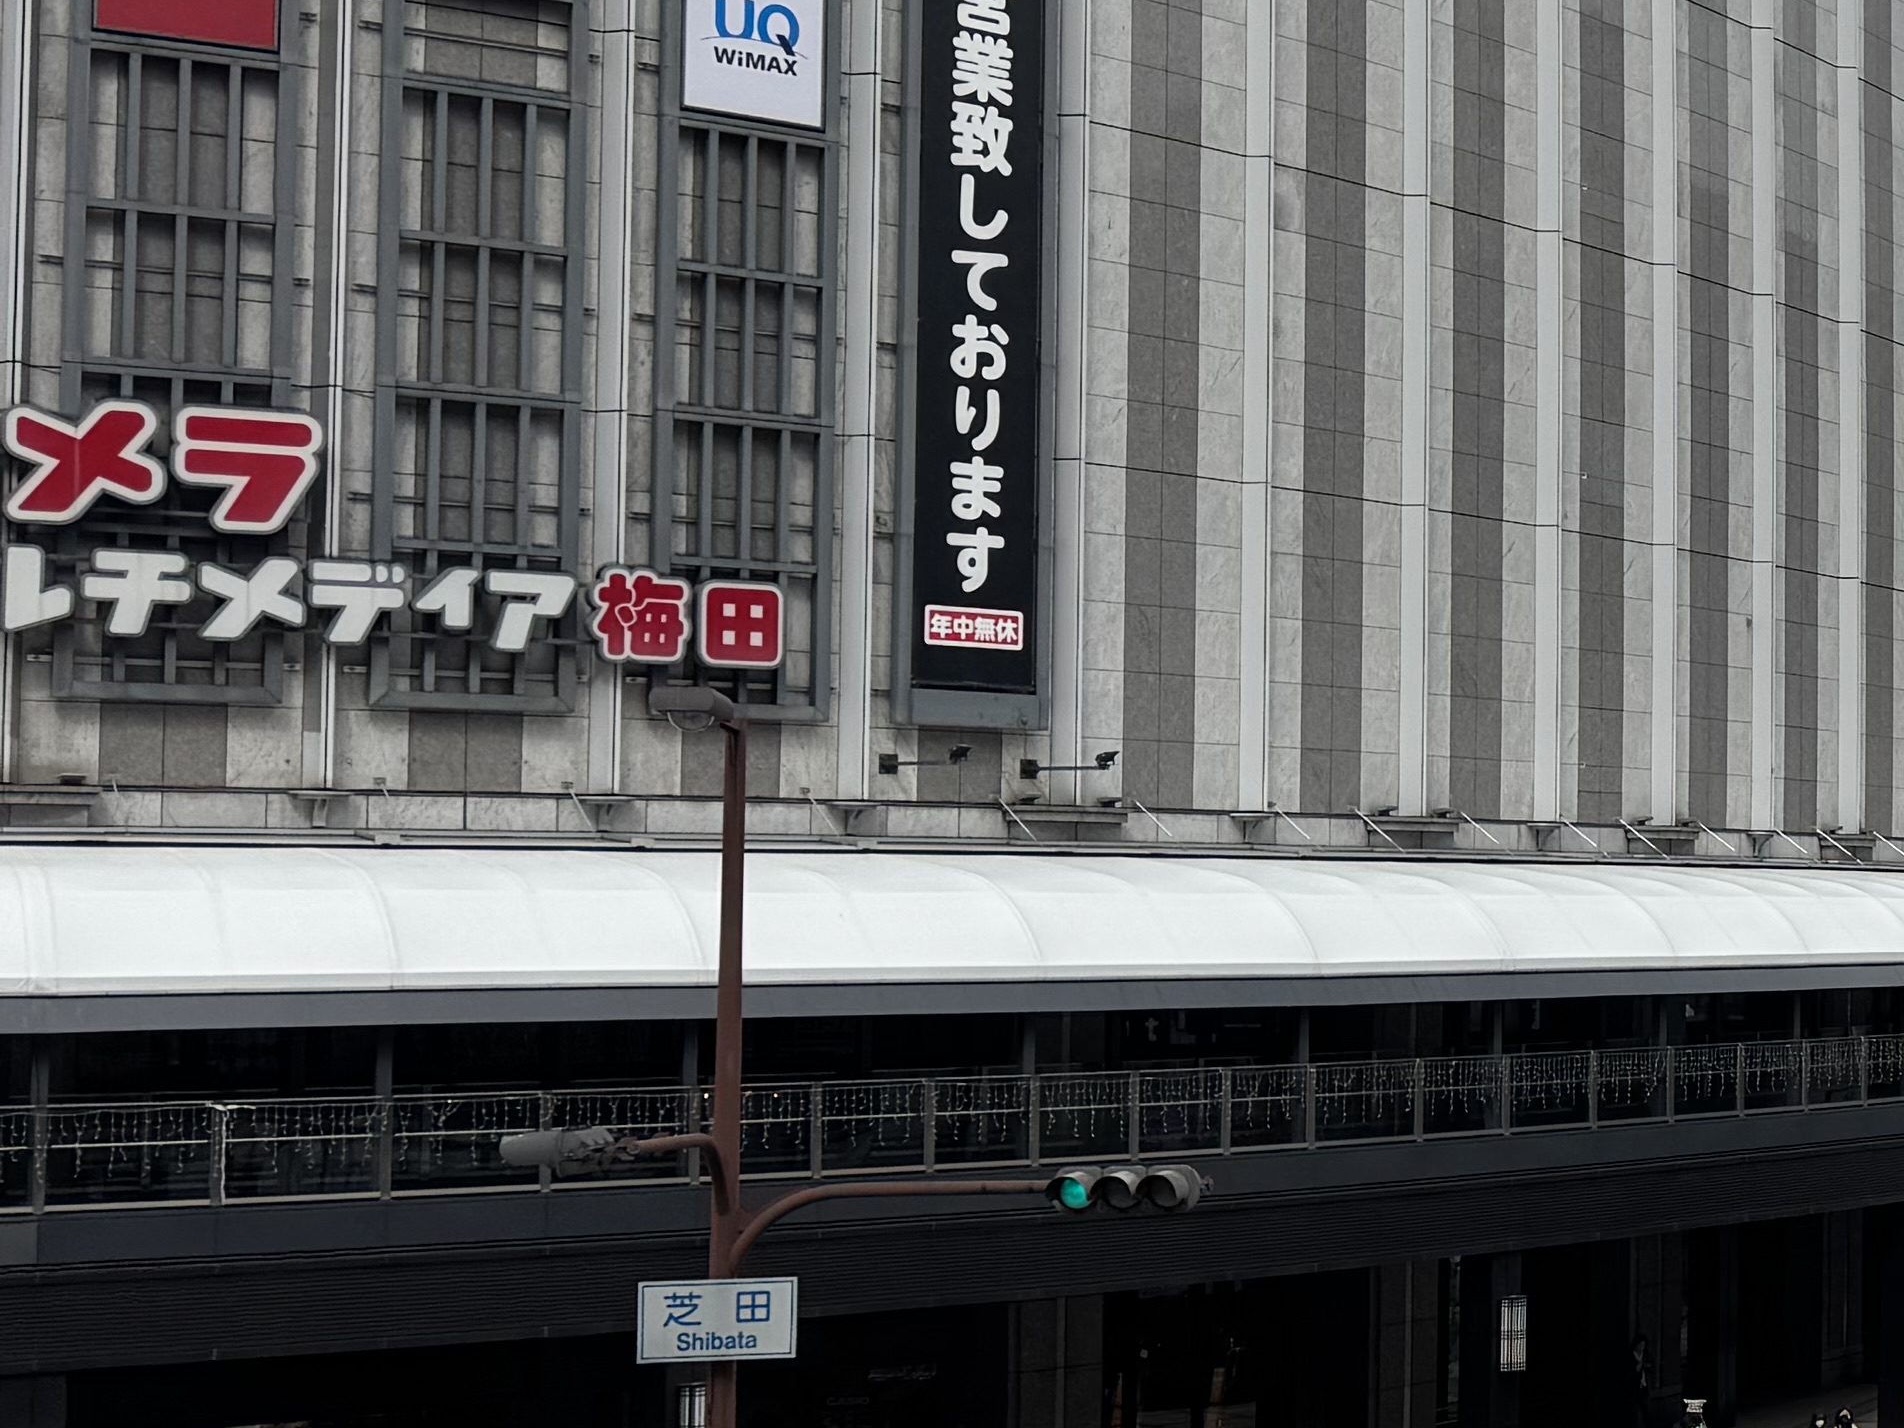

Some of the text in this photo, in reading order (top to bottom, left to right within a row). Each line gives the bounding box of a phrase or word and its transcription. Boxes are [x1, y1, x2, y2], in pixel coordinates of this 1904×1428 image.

[712, 44, 799, 79] WiMAX
[5, 397, 324, 534] メラ
[591, 563, 787, 669] 梅田
[927, 610, 1021, 647] 年中無休
[663, 1290, 772, 1328] 芝田
[676, 1330, 758, 1353] Shibata
